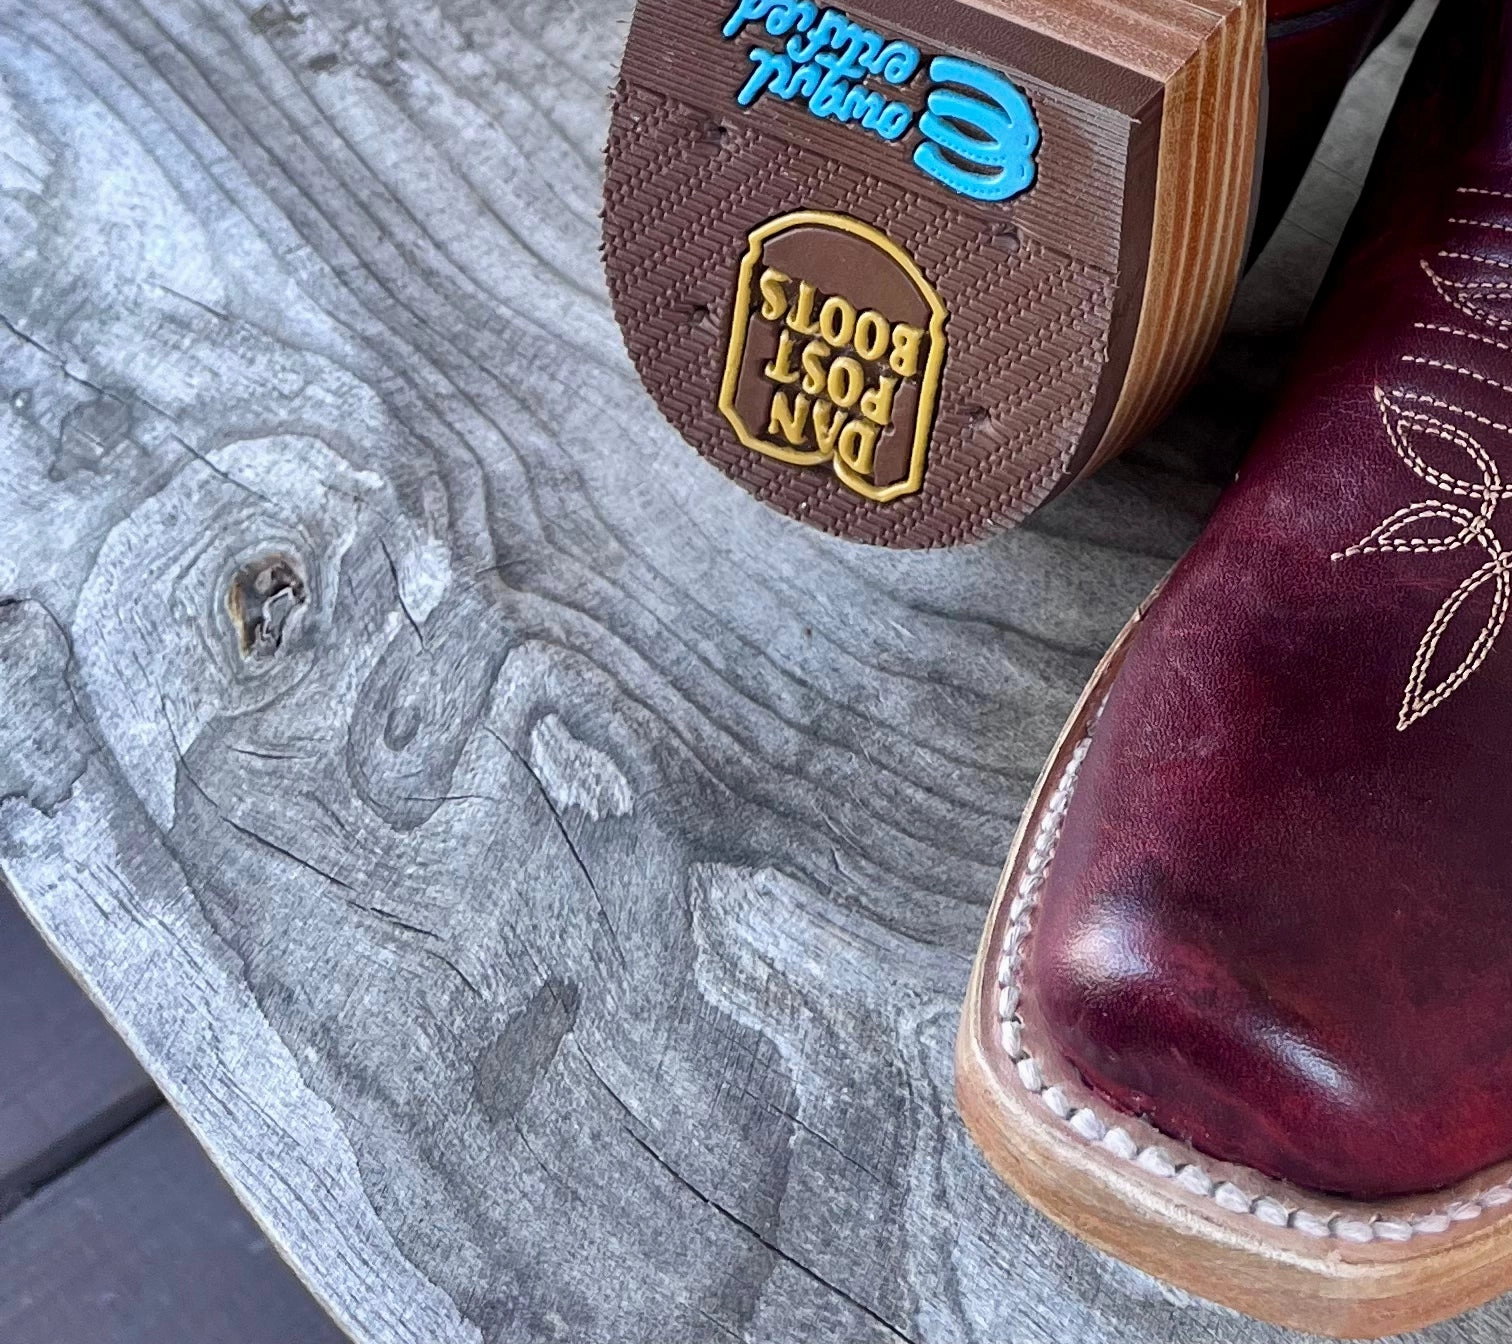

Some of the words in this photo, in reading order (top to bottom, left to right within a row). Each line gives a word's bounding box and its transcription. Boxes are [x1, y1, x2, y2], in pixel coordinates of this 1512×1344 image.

[738, 47, 1037, 201] Cowgirl
[759, 269, 924, 376] BOOTS
[765, 331, 899, 425] POST
[770, 393, 878, 474] DAN
